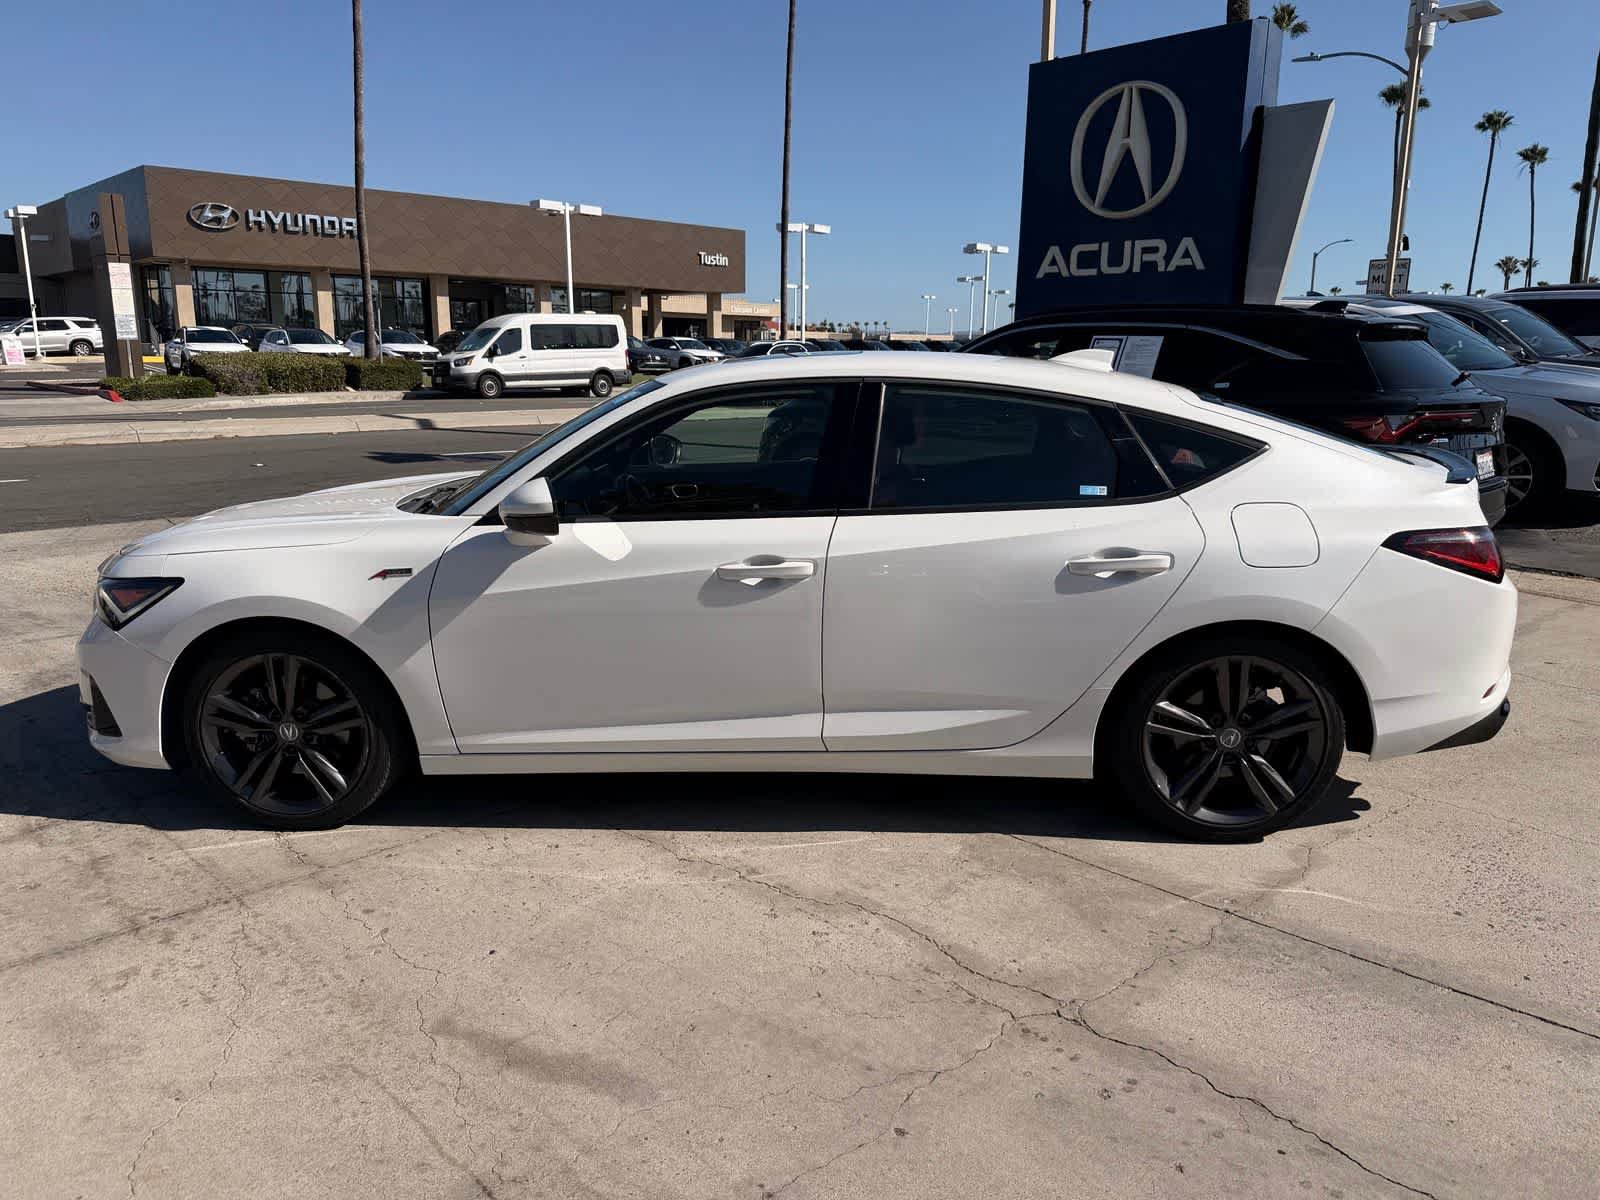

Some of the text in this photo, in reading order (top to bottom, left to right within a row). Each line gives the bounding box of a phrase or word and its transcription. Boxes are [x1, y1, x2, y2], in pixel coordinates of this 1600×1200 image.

[246, 208, 358, 239] HYUNDA
[698, 251, 729, 267] Tustin
[1035, 236, 1206, 279] ACURA
